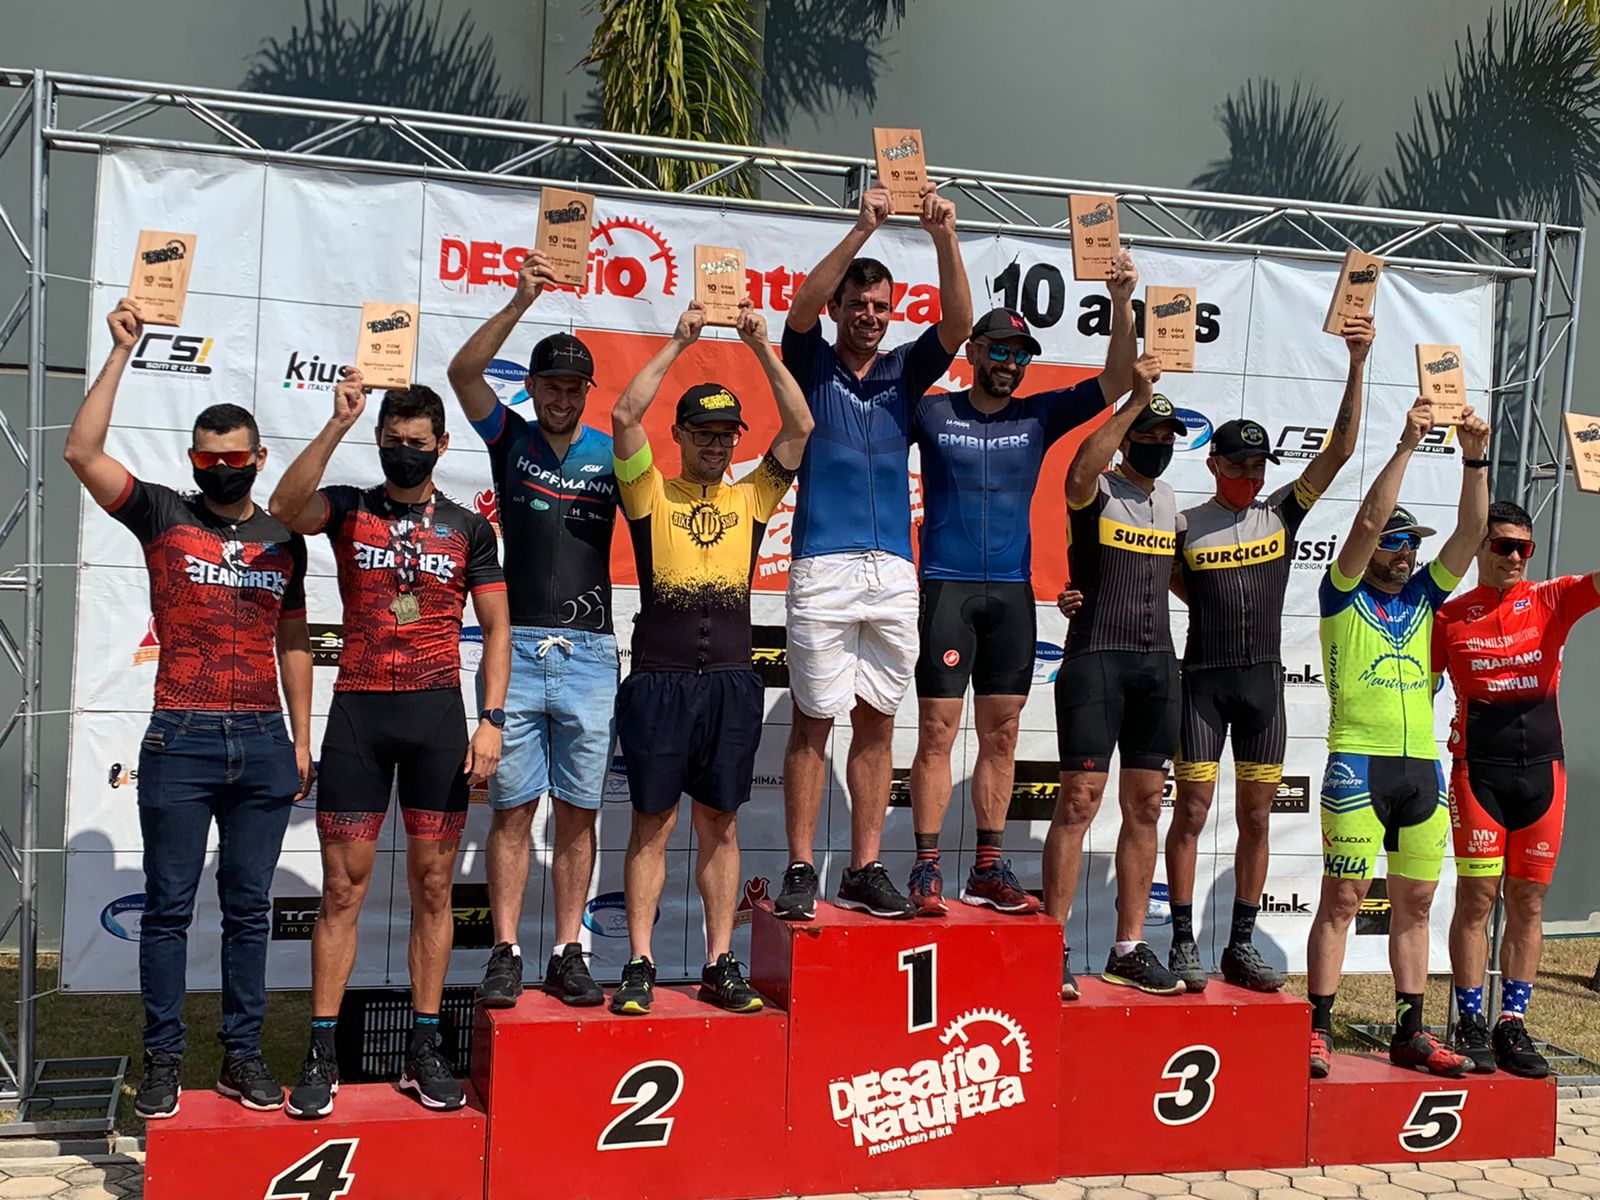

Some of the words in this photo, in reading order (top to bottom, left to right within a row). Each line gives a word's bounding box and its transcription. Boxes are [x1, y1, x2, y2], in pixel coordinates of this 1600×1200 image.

[707, 284, 717, 292] 10
[993, 256, 1066, 328] 10
[1157, 328, 1167, 336] 10
[370, 343, 382, 352] 10
[307, 384, 331, 392] ITALY
[938, 433, 1030, 451] BMBIKERS
[516, 456, 614, 495] HOFFMANN
[673, 512, 690, 529] BIKE
[1196, 540, 1279, 565] SURCICLO
[1294, 562, 1322, 570] DESIGN
[1331, 836, 1372, 844] AUDAX
[1472, 830, 1498, 843] My
[898, 942, 938, 1034] 1
[1153, 1044, 1221, 1126] 3
[597, 1060, 684, 1151] 2
[1399, 1090, 1468, 1152] 5
[868, 1132, 929, 1157] mountain
[264, 1138, 360, 1200] 4
